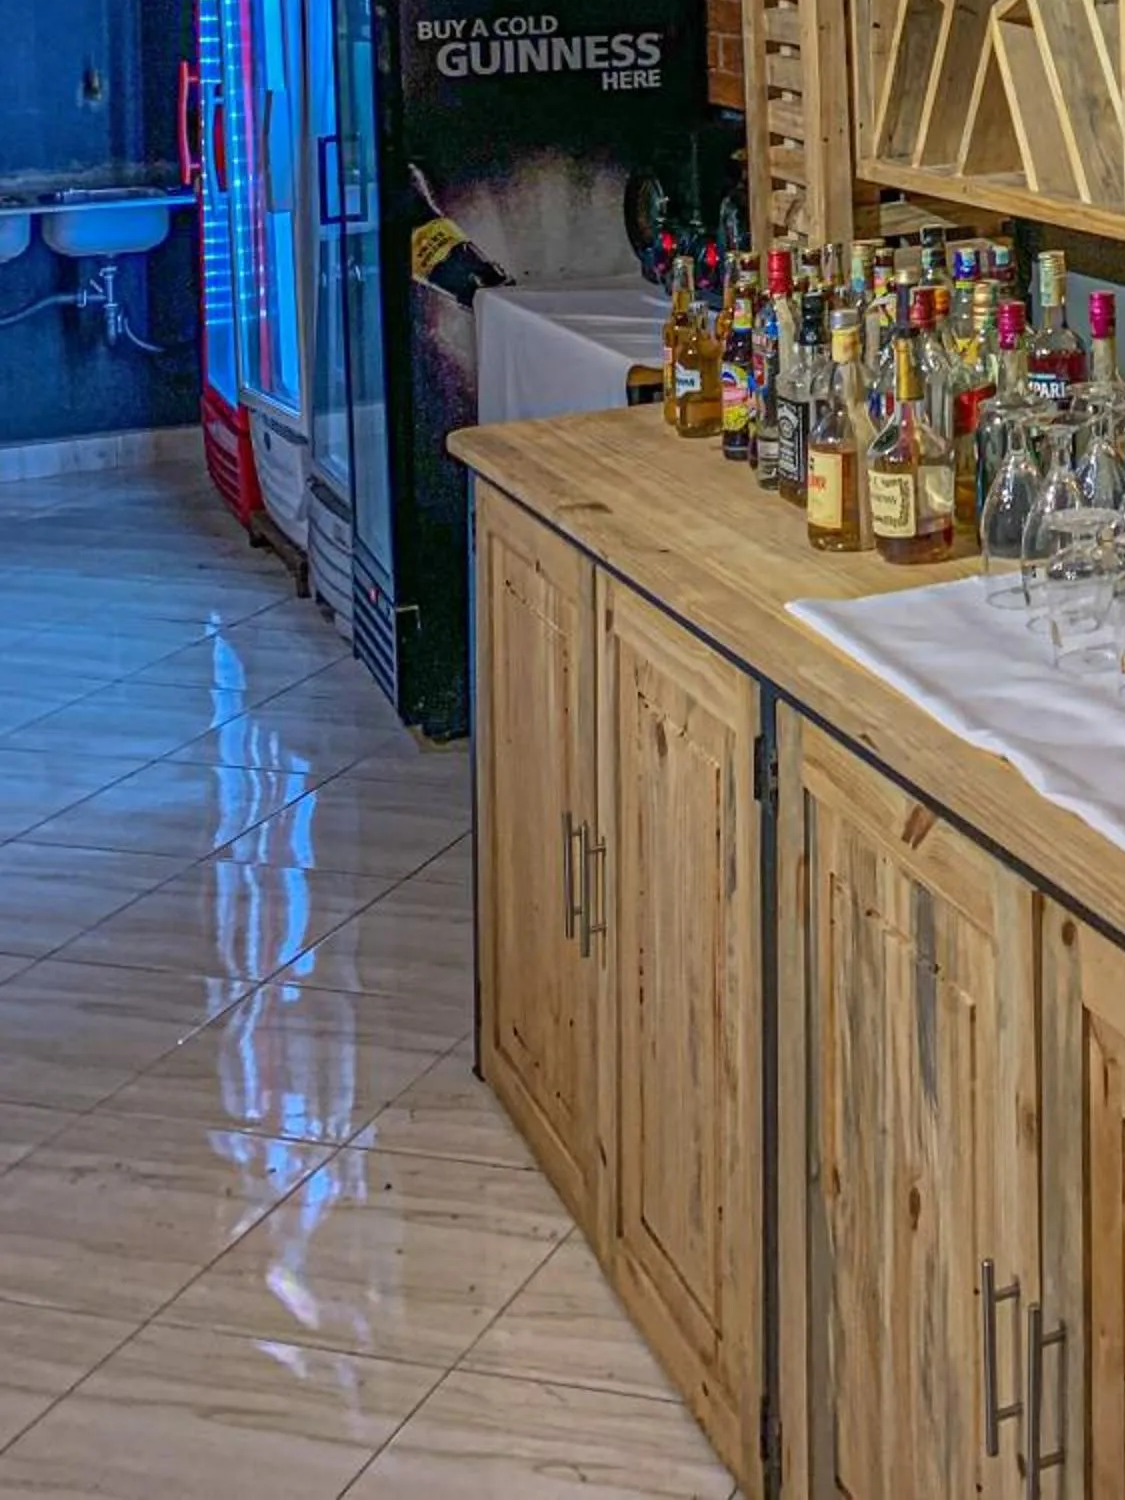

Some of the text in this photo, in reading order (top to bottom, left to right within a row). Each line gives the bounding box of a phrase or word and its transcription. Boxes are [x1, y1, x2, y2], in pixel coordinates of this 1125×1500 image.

[417, 15, 558, 41] BUY A COLD
[437, 32, 661, 77] GUINNESS
[602, 69, 661, 90] HERE
[1028, 380, 1065, 399] PARI
